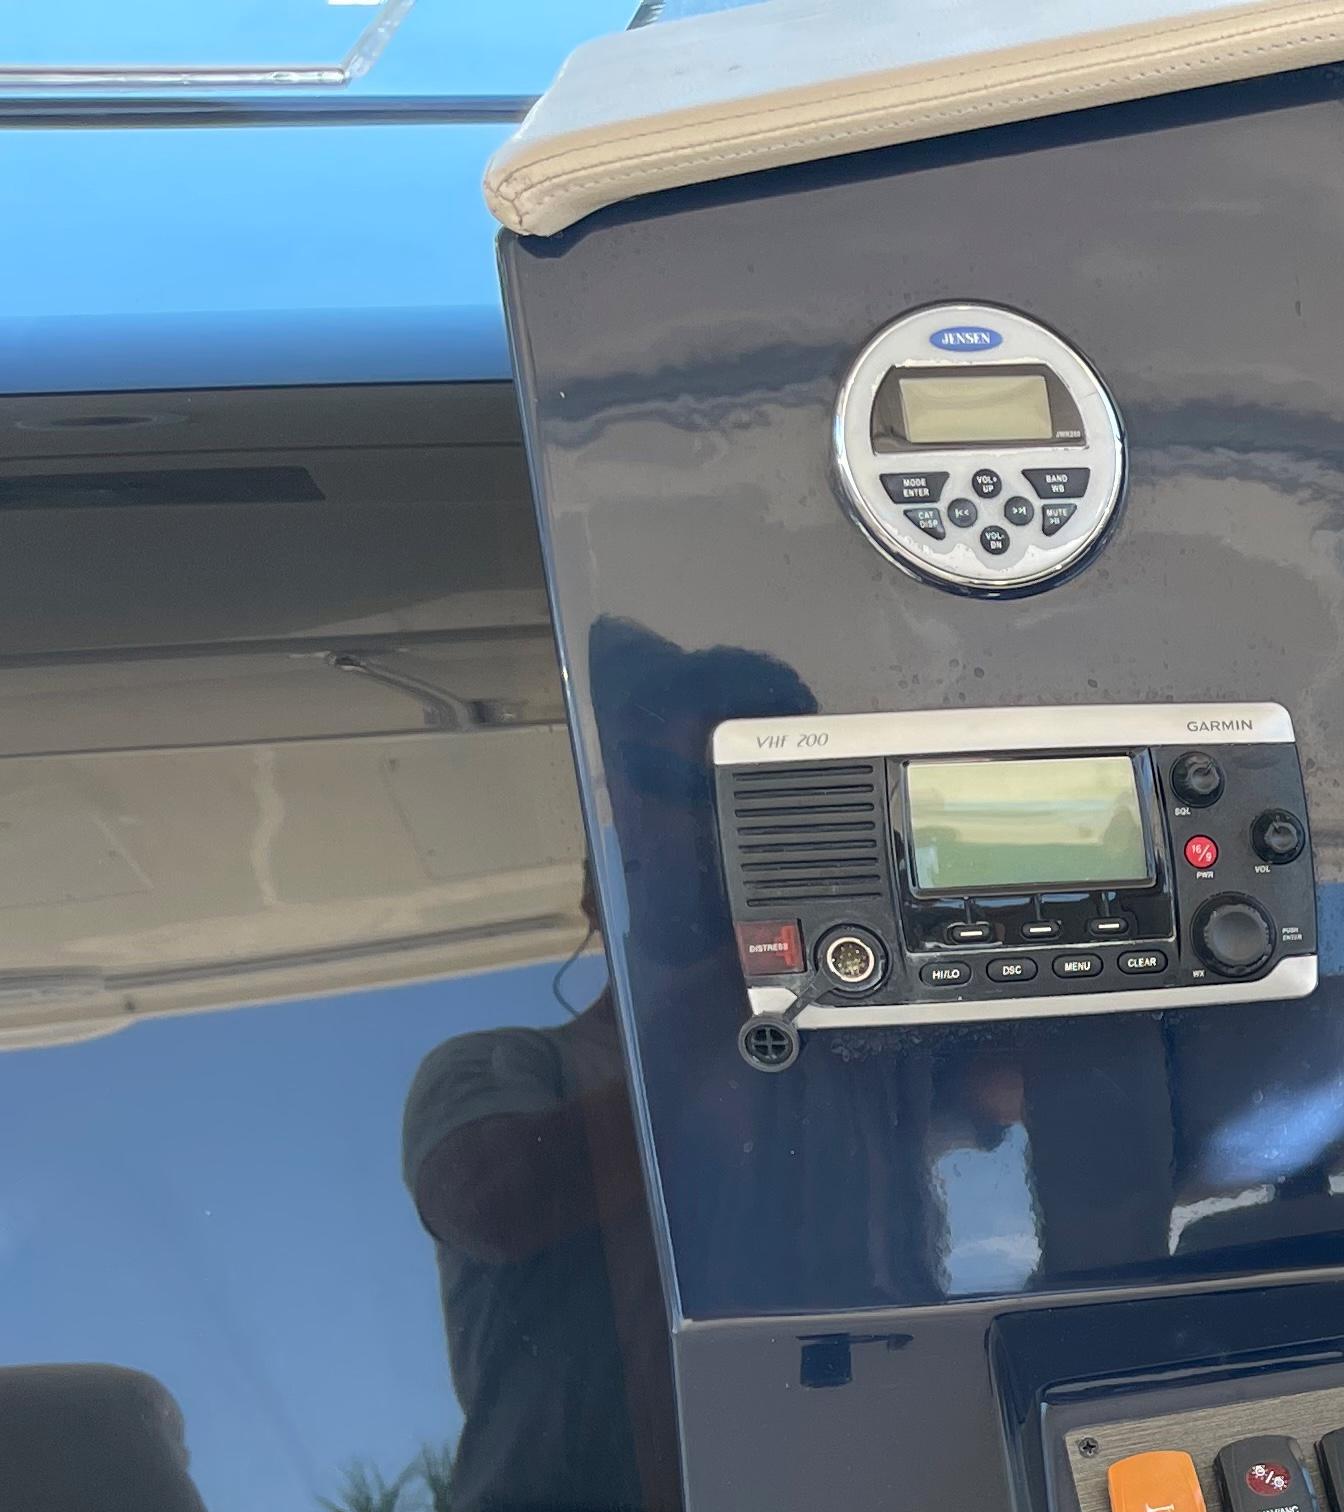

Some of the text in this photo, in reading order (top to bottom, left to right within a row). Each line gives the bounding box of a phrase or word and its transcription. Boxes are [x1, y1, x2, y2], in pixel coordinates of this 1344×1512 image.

[941, 332, 990, 345] JENSEN
[903, 478, 926, 487] MODE
[1046, 475, 1067, 483] BAND
[903, 487, 929, 498] ENTER
[983, 485, 993, 493] UP
[918, 511, 933, 519] CAT
[1046, 508, 1067, 517] MUTE
[920, 519, 938, 528] DISP
[990, 540, 1002, 549] DN
[1187, 719, 1253, 733] GARMIN
[756, 733, 829, 749] VHF 200
[1191, 844, 1213, 862] 16/9
[1254, 865, 1271, 874] VOL
[748, 943, 789, 953] DISTRESS
[932, 956, 1157, 980] HI/LO DSC MENU CLEAR
